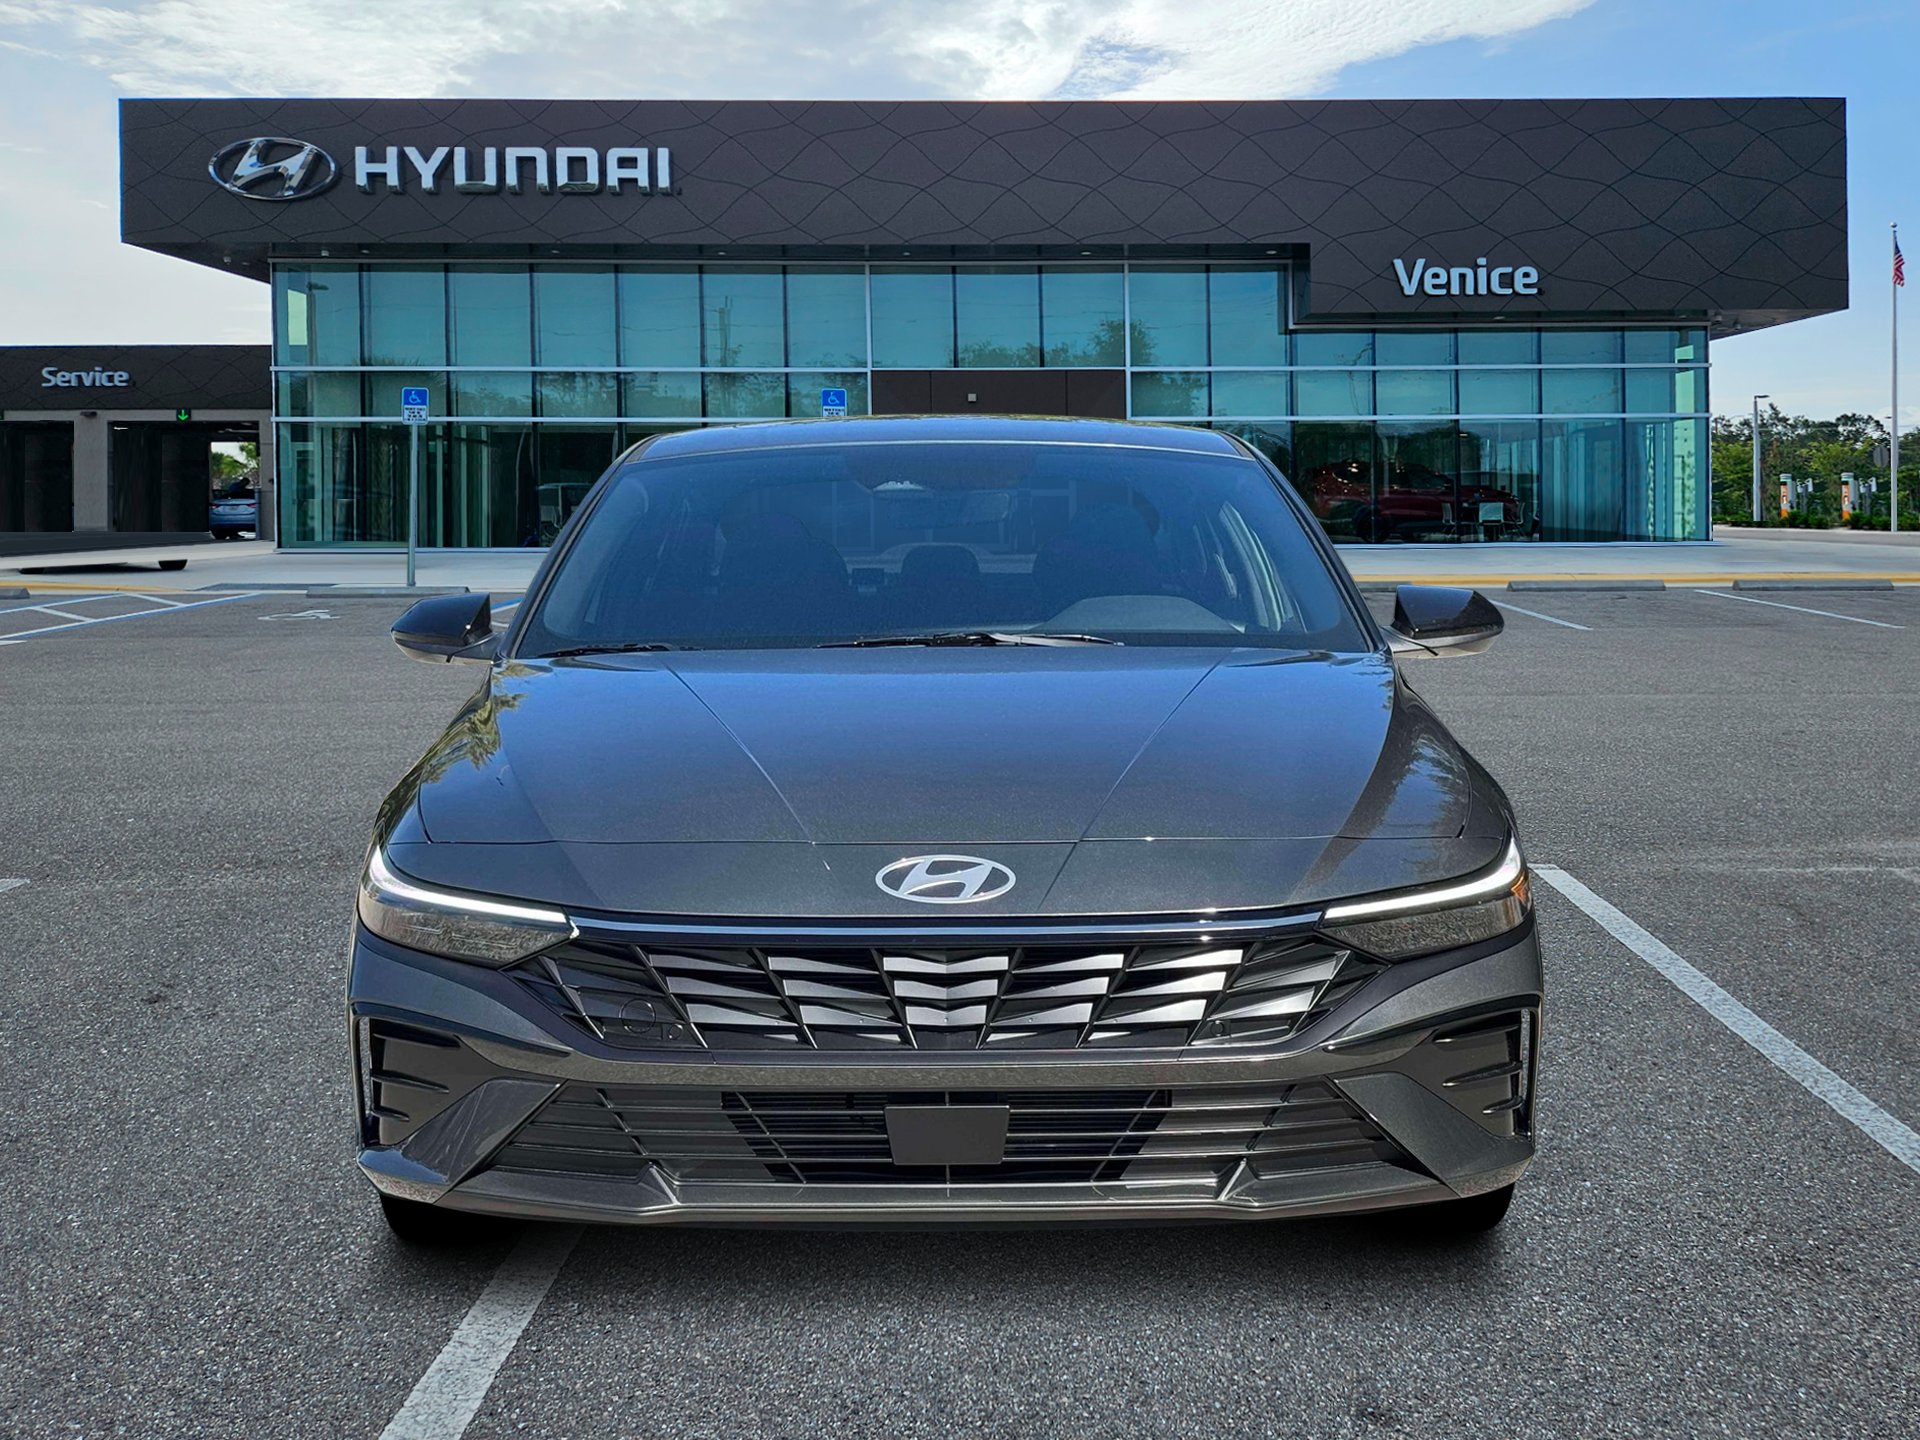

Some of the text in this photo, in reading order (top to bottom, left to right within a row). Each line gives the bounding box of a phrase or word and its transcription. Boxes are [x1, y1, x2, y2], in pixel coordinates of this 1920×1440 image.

[354, 146, 671, 194] HYUNDAI
[1392, 257, 1540, 296] Venice
[41, 366, 130, 388] Service
